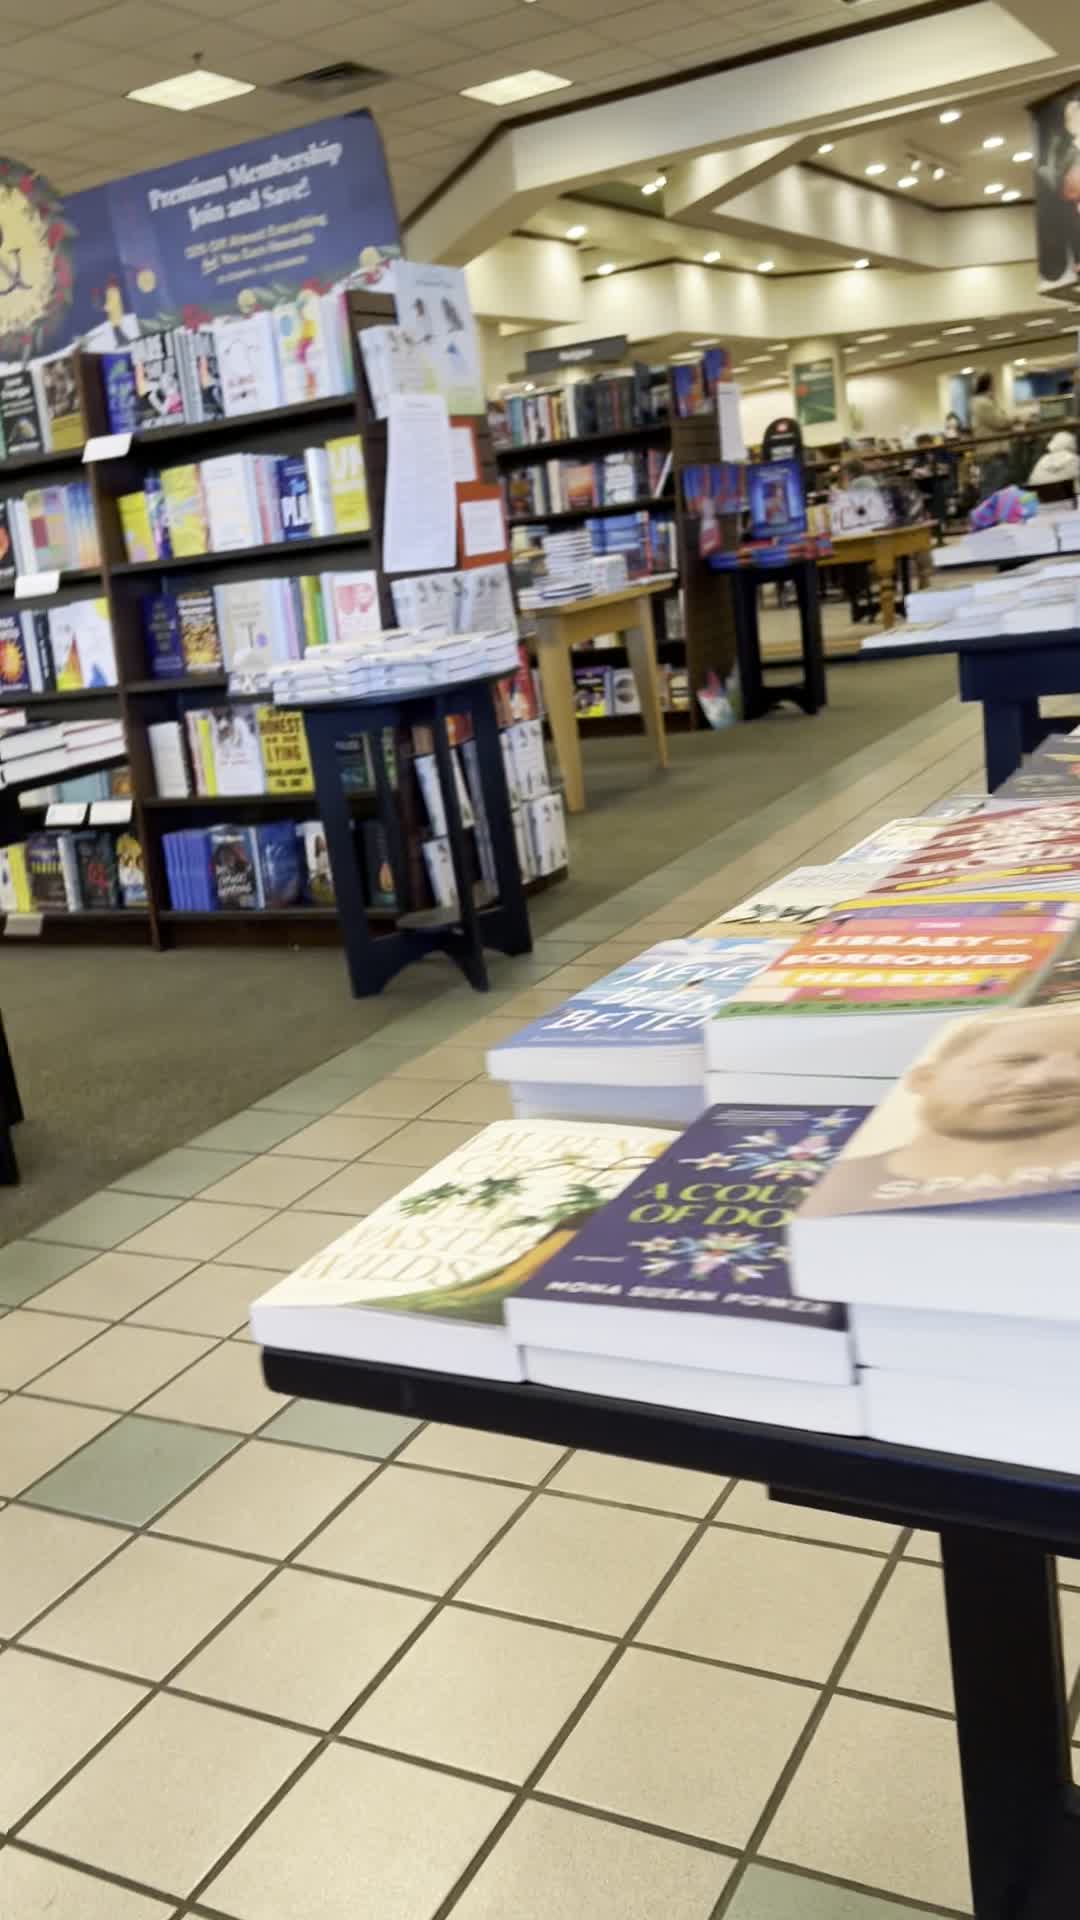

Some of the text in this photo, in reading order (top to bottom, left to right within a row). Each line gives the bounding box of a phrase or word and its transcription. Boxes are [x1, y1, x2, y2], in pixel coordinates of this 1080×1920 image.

[148, 140, 343, 212] Premium Membership
[188, 176, 312, 232] Join and Save!
[811, 935, 994, 948] LIBRARY
[778, 953, 1032, 966] BORROWED
[631, 1182, 669, 1200] A
[627, 1203, 704, 1224] OF
[544, 1280, 622, 1296] MONA
[627, 1285, 719, 1302] SUSAN
